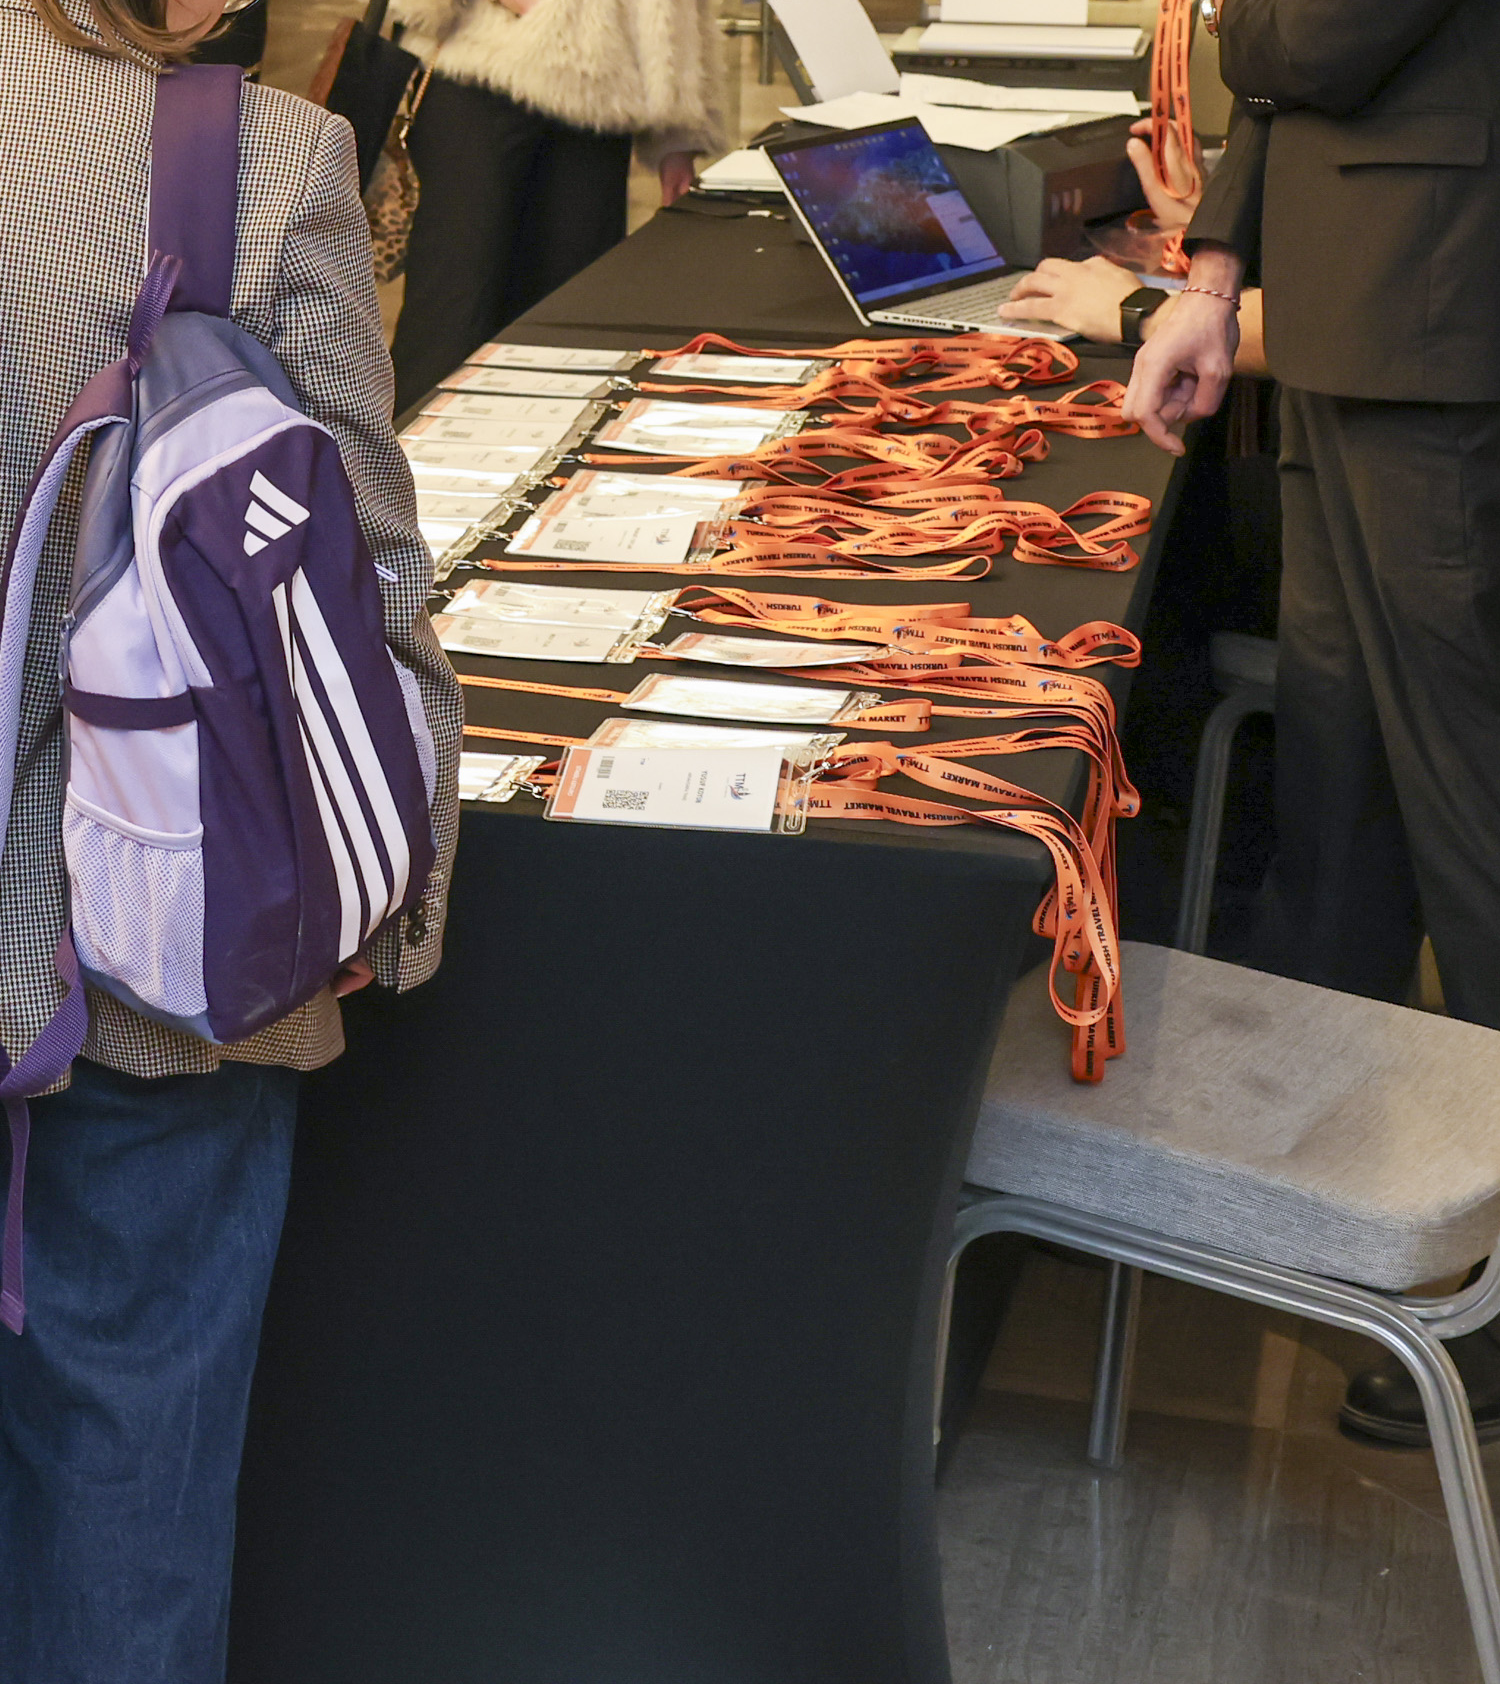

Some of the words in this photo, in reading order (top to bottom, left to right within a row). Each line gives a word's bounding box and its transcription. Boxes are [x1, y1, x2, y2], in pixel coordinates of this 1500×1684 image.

[804, 505, 831, 514] TRAVEL
[833, 509, 864, 518] MARKET
[722, 556, 753, 566] MARKET
[755, 553, 781, 561] TRAVEL
[766, 603, 802, 611] TURKISH
[906, 629, 925, 638] TTM
[1092, 632, 1108, 642] TTM
[935, 636, 966, 646] MARKET
[967, 640, 991, 649] TRAVEL
[992, 643, 1028, 652] TURKISH
[990, 677, 1027, 687] TURKISH
[1052, 682, 1073, 691] TTM
[909, 757, 930, 772] TTM
[735, 773, 746, 790] TTM
[941, 771, 980, 788] MARKET
[983, 782, 1017, 798] TRAVEL
[808, 799, 832, 809] TTM
[844, 802, 884, 812] MARKET
[887, 806, 921, 820] TRAVEL
[923, 812, 967, 820] TURKISH
[1066, 883, 1077, 904] TTM
[1092, 906, 1107, 943] TRAVEL
